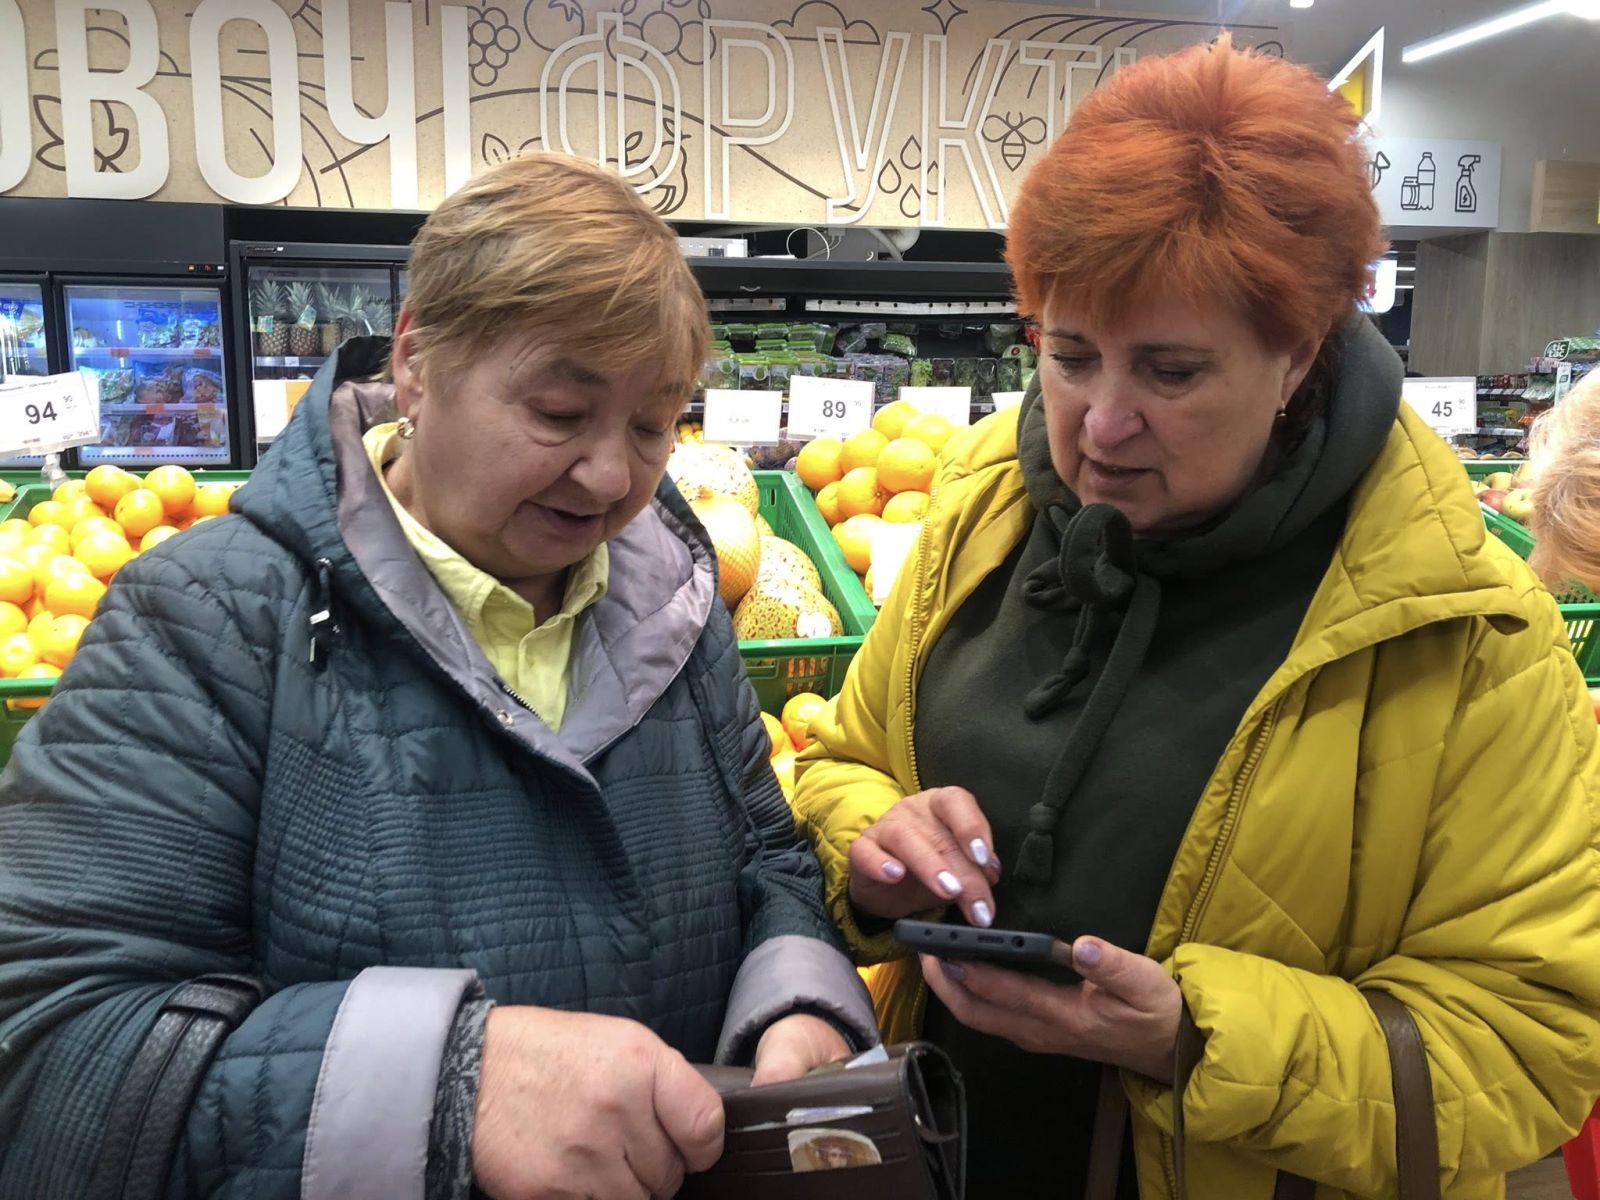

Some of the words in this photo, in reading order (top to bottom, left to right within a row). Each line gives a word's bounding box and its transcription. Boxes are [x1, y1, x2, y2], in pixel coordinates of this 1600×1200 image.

[540, 12, 1137, 230] ФРУКТ
[1552, 342, 1567, 351] tic
[25, 401, 58, 425] 94
[822, 400, 847, 419] 89
[1432, 401, 1453, 417] 45
